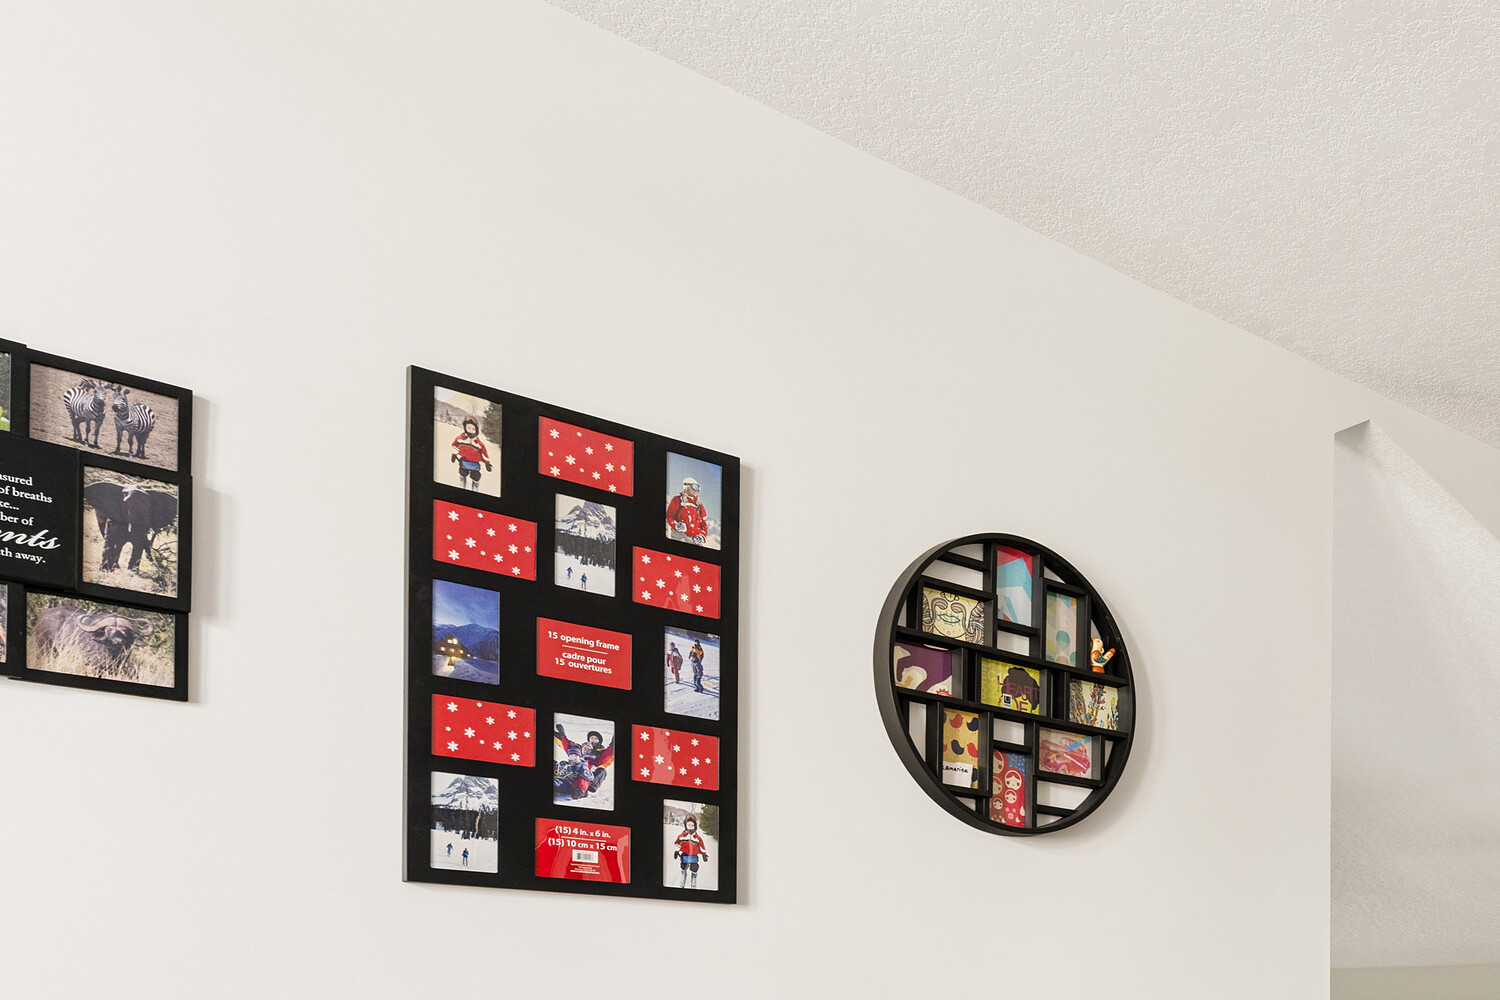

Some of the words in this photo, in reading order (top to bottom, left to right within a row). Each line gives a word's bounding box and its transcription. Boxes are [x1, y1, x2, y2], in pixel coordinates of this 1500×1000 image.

[12, 487, 53, 503] breaths
[21, 516, 34, 526] of
[15, 551, 46, 564] away.
[547, 631, 558, 640] 15
[560, 635, 595, 648] opening
[596, 640, 620, 651] frame
[555, 657, 565, 666] 15
[568, 661, 613, 674] ouvertures
[562, 652, 586, 662] cadre
[587, 656, 608, 666] pour
[555, 826, 572, 835] (15)
[602, 831, 611, 839] in.
[548, 838, 565, 848] (15)
[567, 840, 577, 848] 10
